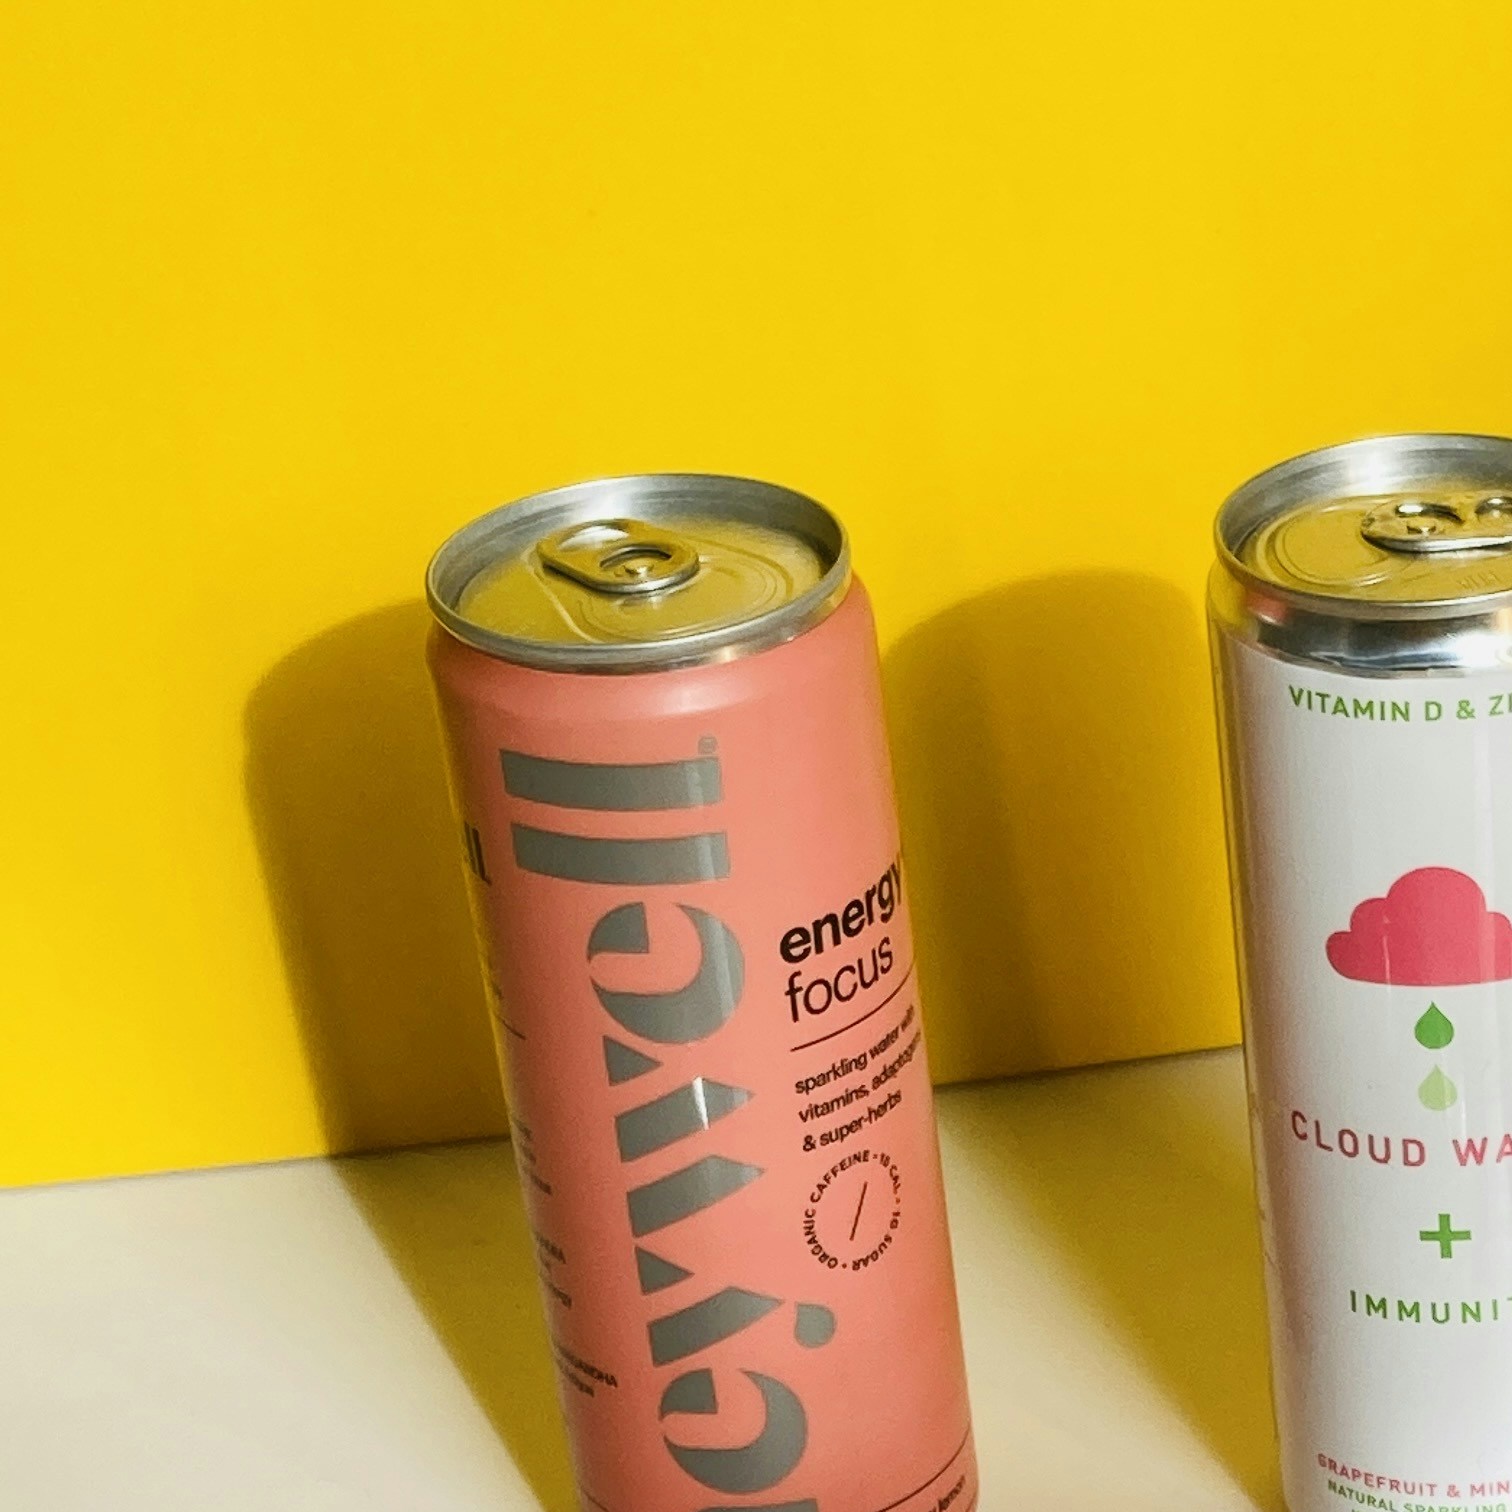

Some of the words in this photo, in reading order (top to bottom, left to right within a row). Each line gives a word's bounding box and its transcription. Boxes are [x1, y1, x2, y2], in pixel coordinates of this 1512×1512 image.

[1288, 684, 1410, 722] VITAMIN
[1424, 701, 1442, 721] D
[1456, 699, 1476, 720] &
[779, 852, 903, 964] energy
[785, 936, 894, 1023] focus
[795, 1051, 867, 1095] sparkling
[869, 1026, 900, 1061] water
[803, 1134, 816, 1152] &
[820, 1089, 902, 1146] super-herbs
[1291, 1110, 1426, 1167] CLOUD
[810, 1149, 870, 1203] CAFFEINE
[803, 1208, 838, 1269] ORGANIC
[1317, 1453, 1438, 1497] GRAPEFRUIT
[1447, 1484, 1460, 1498] &
